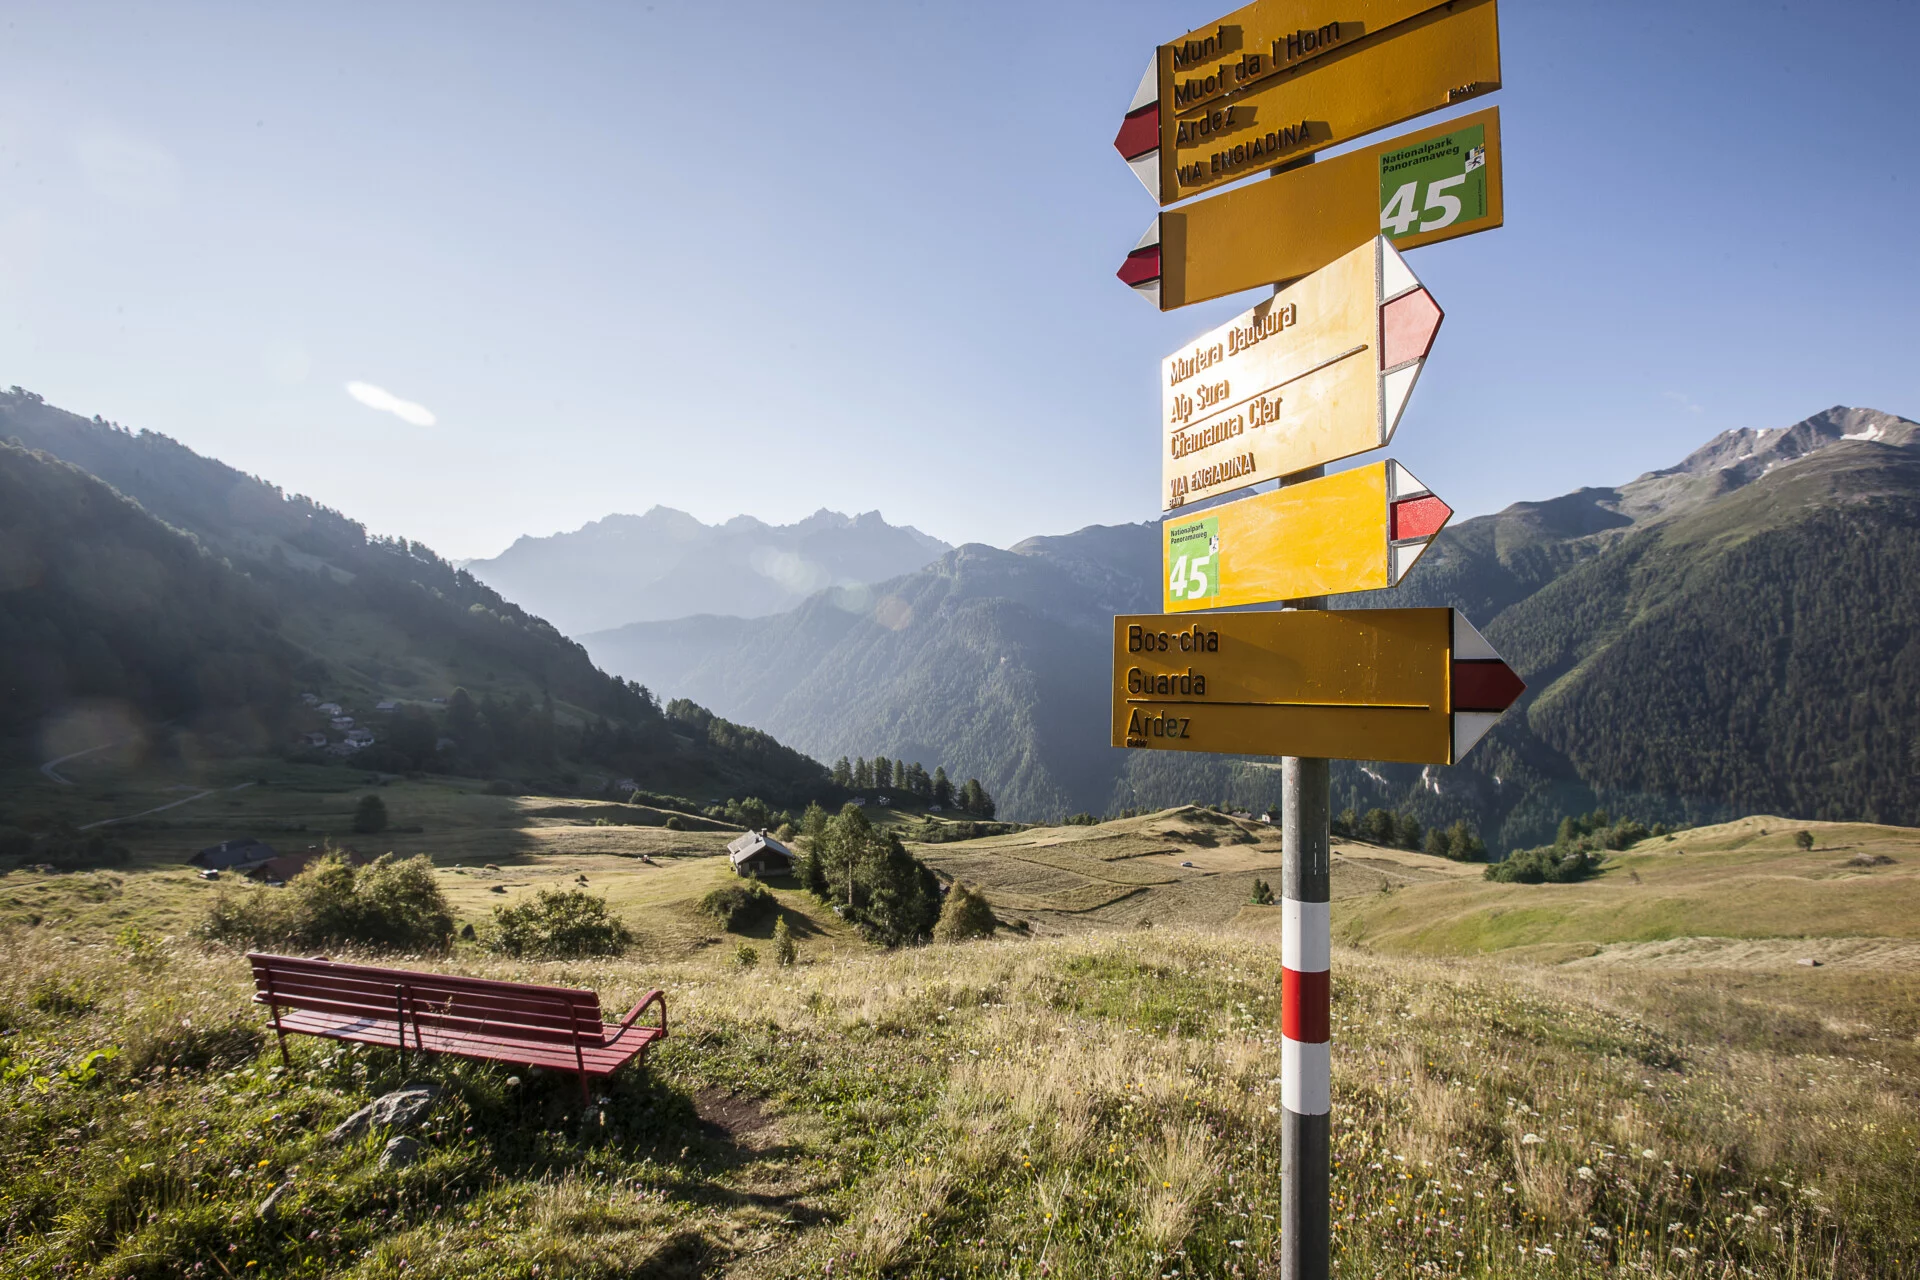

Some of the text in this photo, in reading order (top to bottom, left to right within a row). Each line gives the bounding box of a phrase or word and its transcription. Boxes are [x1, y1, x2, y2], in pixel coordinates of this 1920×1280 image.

[1173, 25, 1224, 72] Munt
[1174, 64, 1225, 107] Muot
[1235, 53, 1261, 82] da
[1175, 105, 1237, 149] Ardez
[1175, 119, 1310, 188] VIA ENGIADINA
[1382, 137, 1453, 165] Nationalpark
[1382, 146, 1460, 174] Panoramaweg
[1381, 173, 1466, 235] 45
[1170, 342, 1224, 387] Murtera
[1170, 380, 1230, 423] Alp Sura
[1171, 396, 1283, 459] Chamanna Cler
[1170, 452, 1256, 497] VIA ENGIADINA
[1170, 523, 1204, 537] Nationalpark
[1170, 531, 1208, 544] Panoramaweg
[1170, 555, 1210, 599] 45
[1127, 667, 1206, 695] Guarda
[1127, 708, 1191, 738] Ardez
